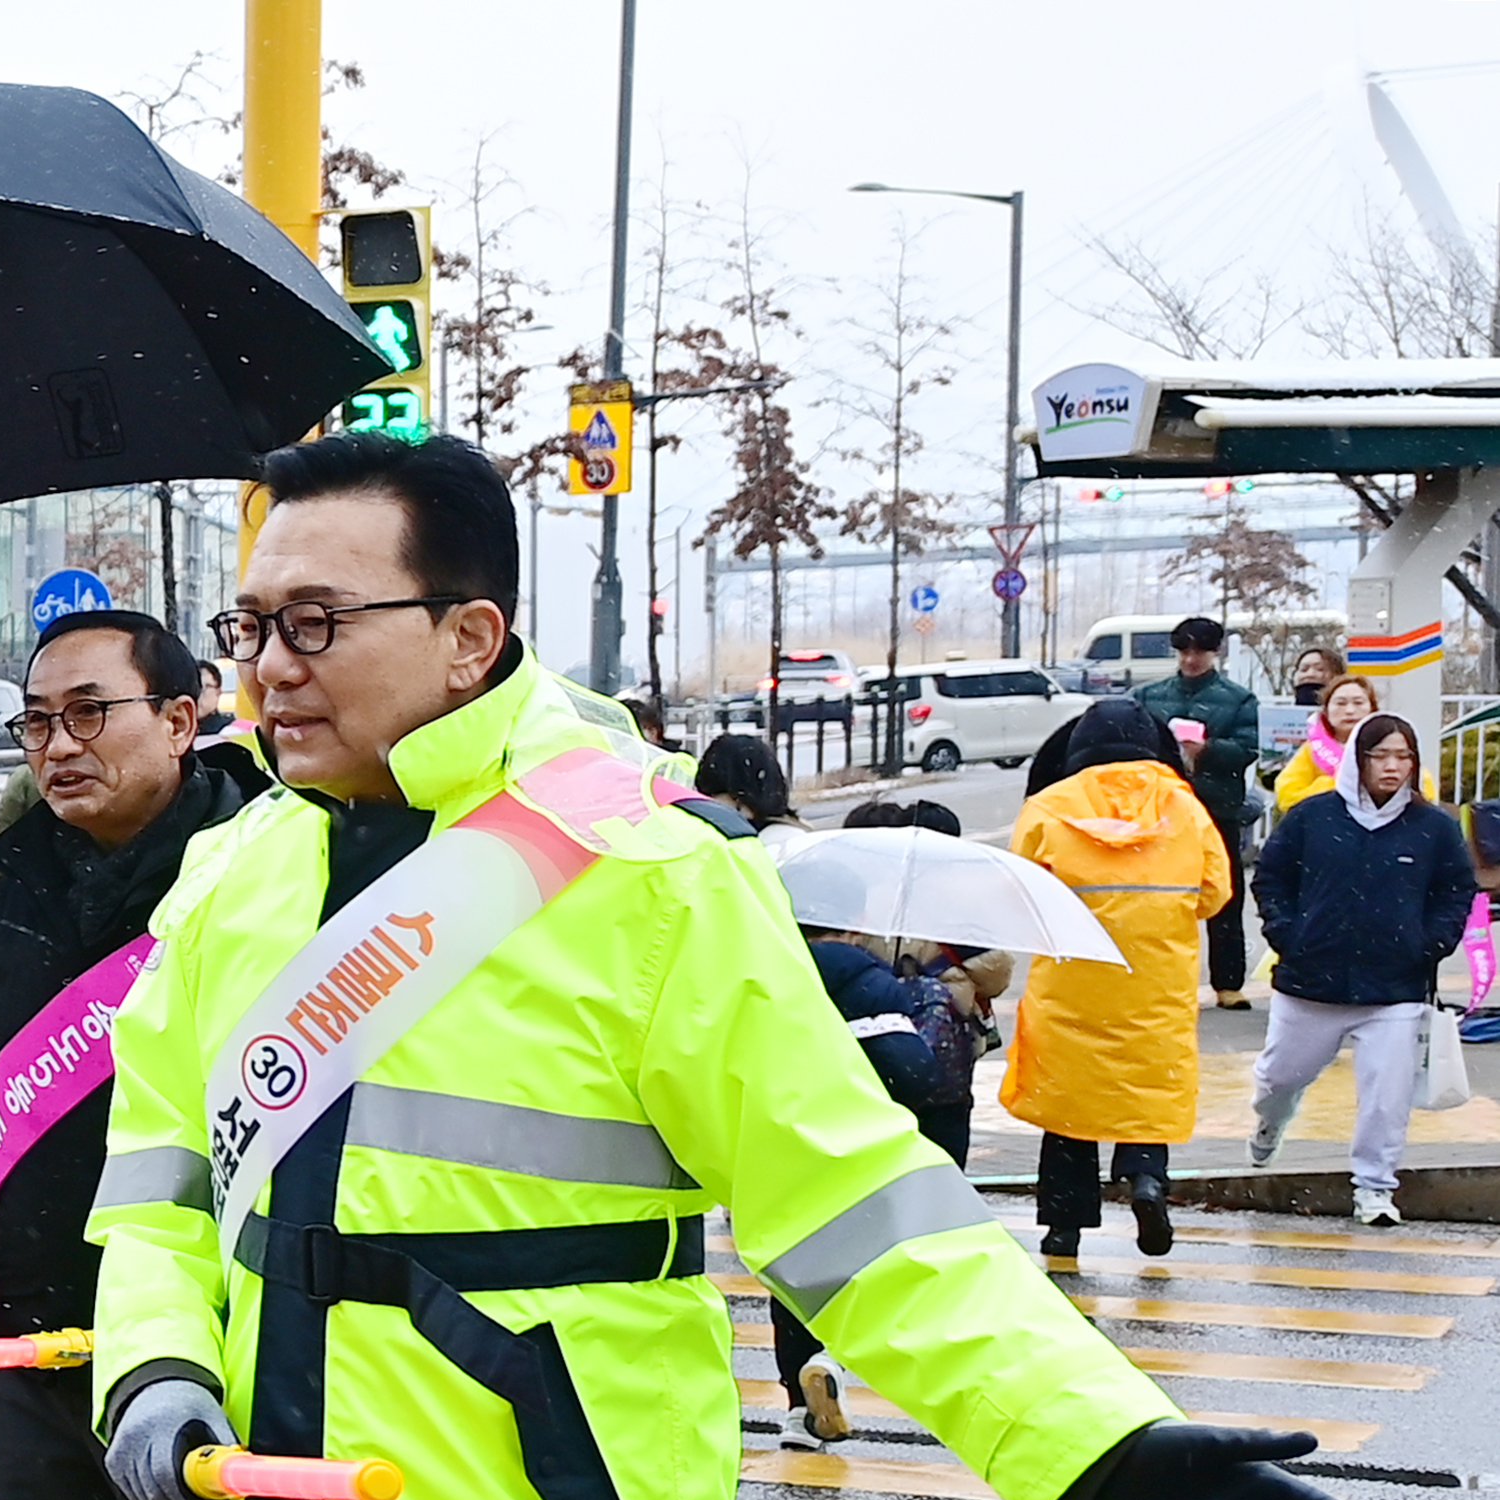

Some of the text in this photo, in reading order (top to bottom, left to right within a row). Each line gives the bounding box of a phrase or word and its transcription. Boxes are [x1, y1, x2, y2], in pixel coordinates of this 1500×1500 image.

[1046, 391, 1129, 428] Yeonsu
[586, 460, 610, 484] 30
[284, 910, 436, 1057] 스쿨존
[250, 1045, 297, 1099] 30
